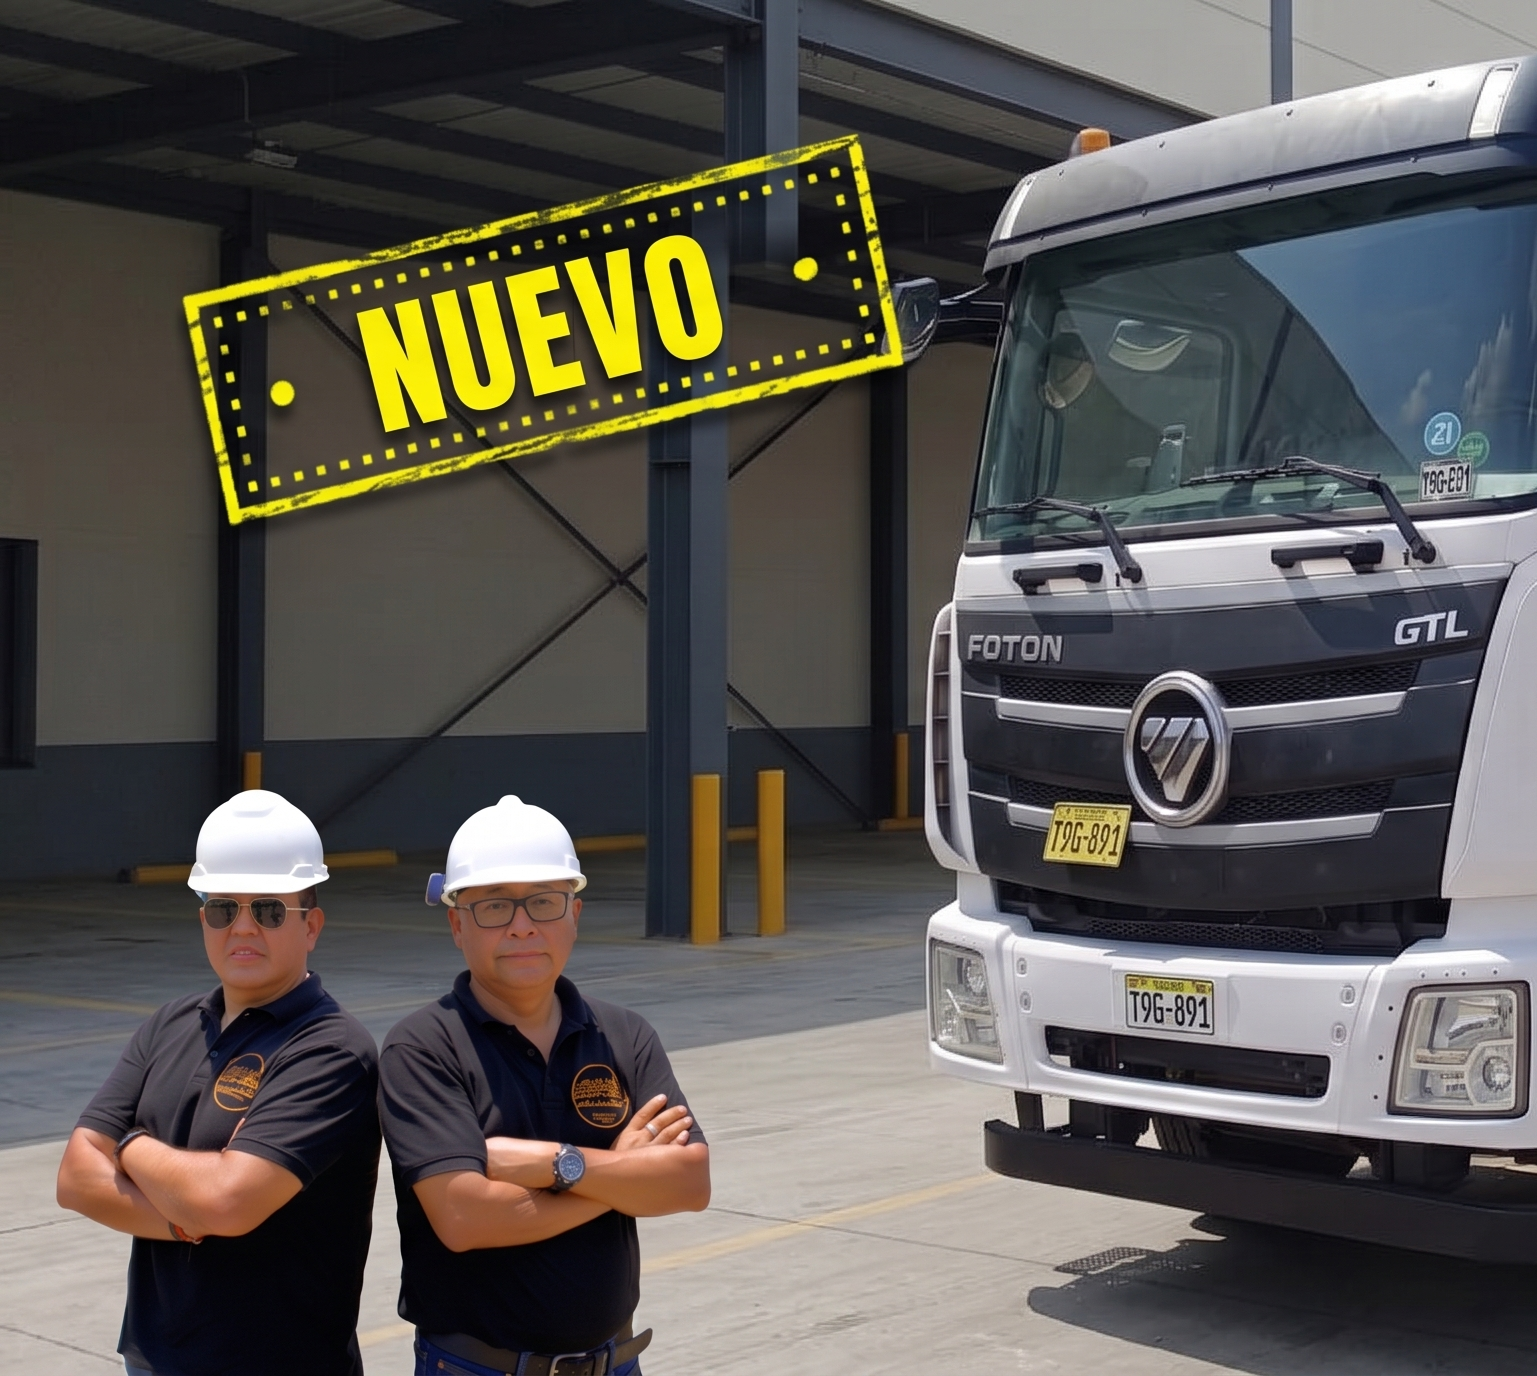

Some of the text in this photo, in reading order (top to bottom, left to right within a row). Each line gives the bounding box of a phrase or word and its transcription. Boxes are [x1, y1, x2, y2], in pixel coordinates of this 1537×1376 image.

[1431, 421, 1453, 446] 21
[1394, 609, 1469, 646] GTL
[967, 634, 1063, 662] FOTON
[1051, 820, 1121, 856] T9G-891
[1129, 991, 1210, 1029] T9G-891
